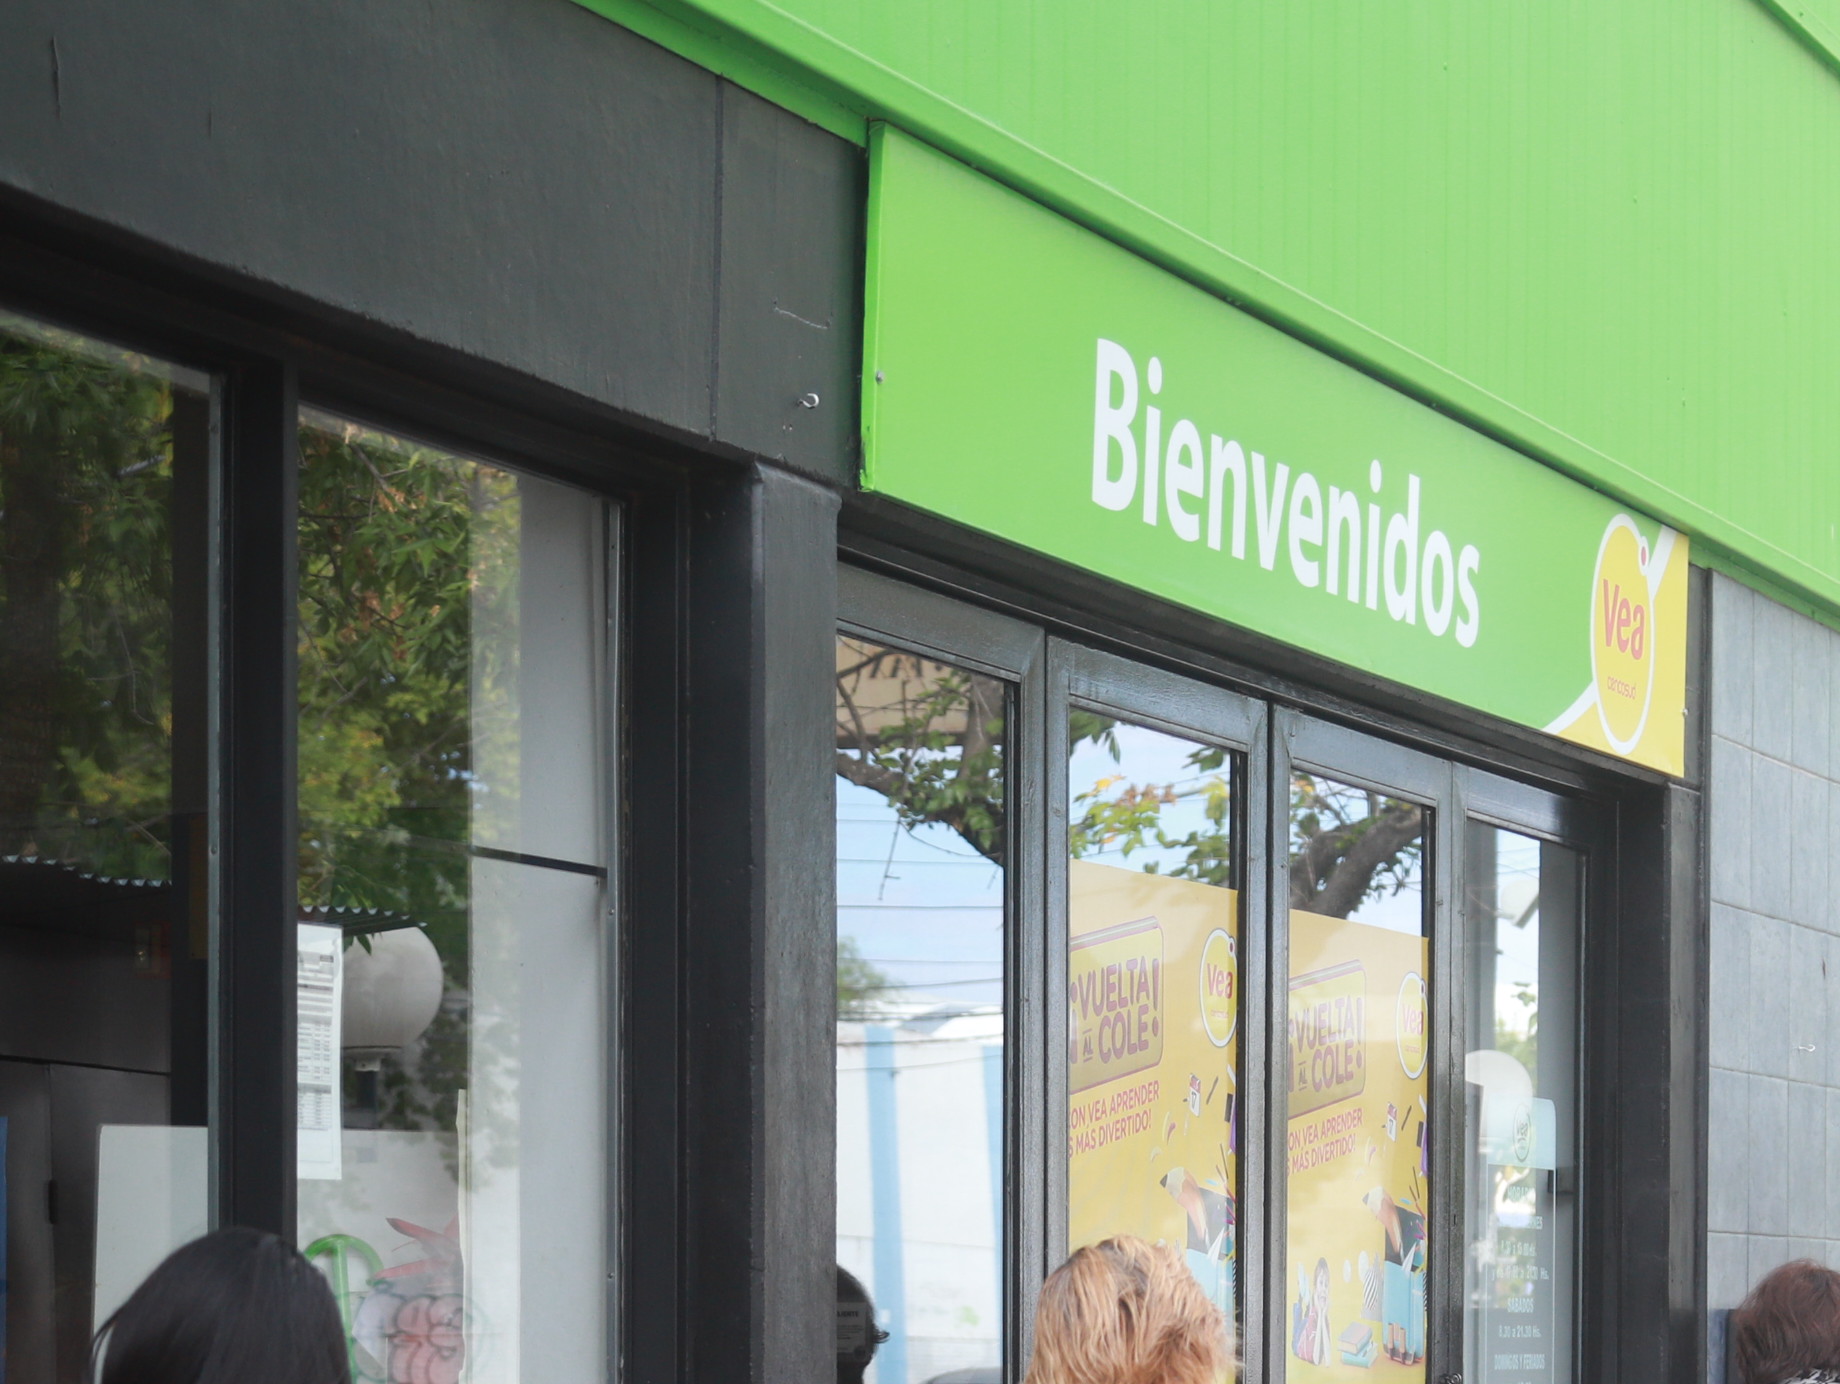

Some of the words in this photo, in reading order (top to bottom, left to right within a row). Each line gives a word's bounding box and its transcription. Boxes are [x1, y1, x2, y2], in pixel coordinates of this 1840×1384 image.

[1092, 338, 1479, 649] Bienvenidos
[1603, 578, 1645, 661] Vea
[1207, 963, 1233, 999] Vea
[1401, 1002, 1424, 1036] Vea
[1083, 1034, 1094, 1058] AL
[1069, 1105, 1086, 1130] ON
[1087, 1098, 1107, 1123] VEA
[1109, 1080, 1160, 1114] APRENDER
[1099, 1107, 1152, 1147] DIVERTIDO!
[1288, 1128, 1301, 1151] ON
[1303, 1123, 1319, 1146] VEA
[1320, 1107, 1363, 1140] APRENDER
[1311, 1133, 1356, 1168] DIVERTIDO!
